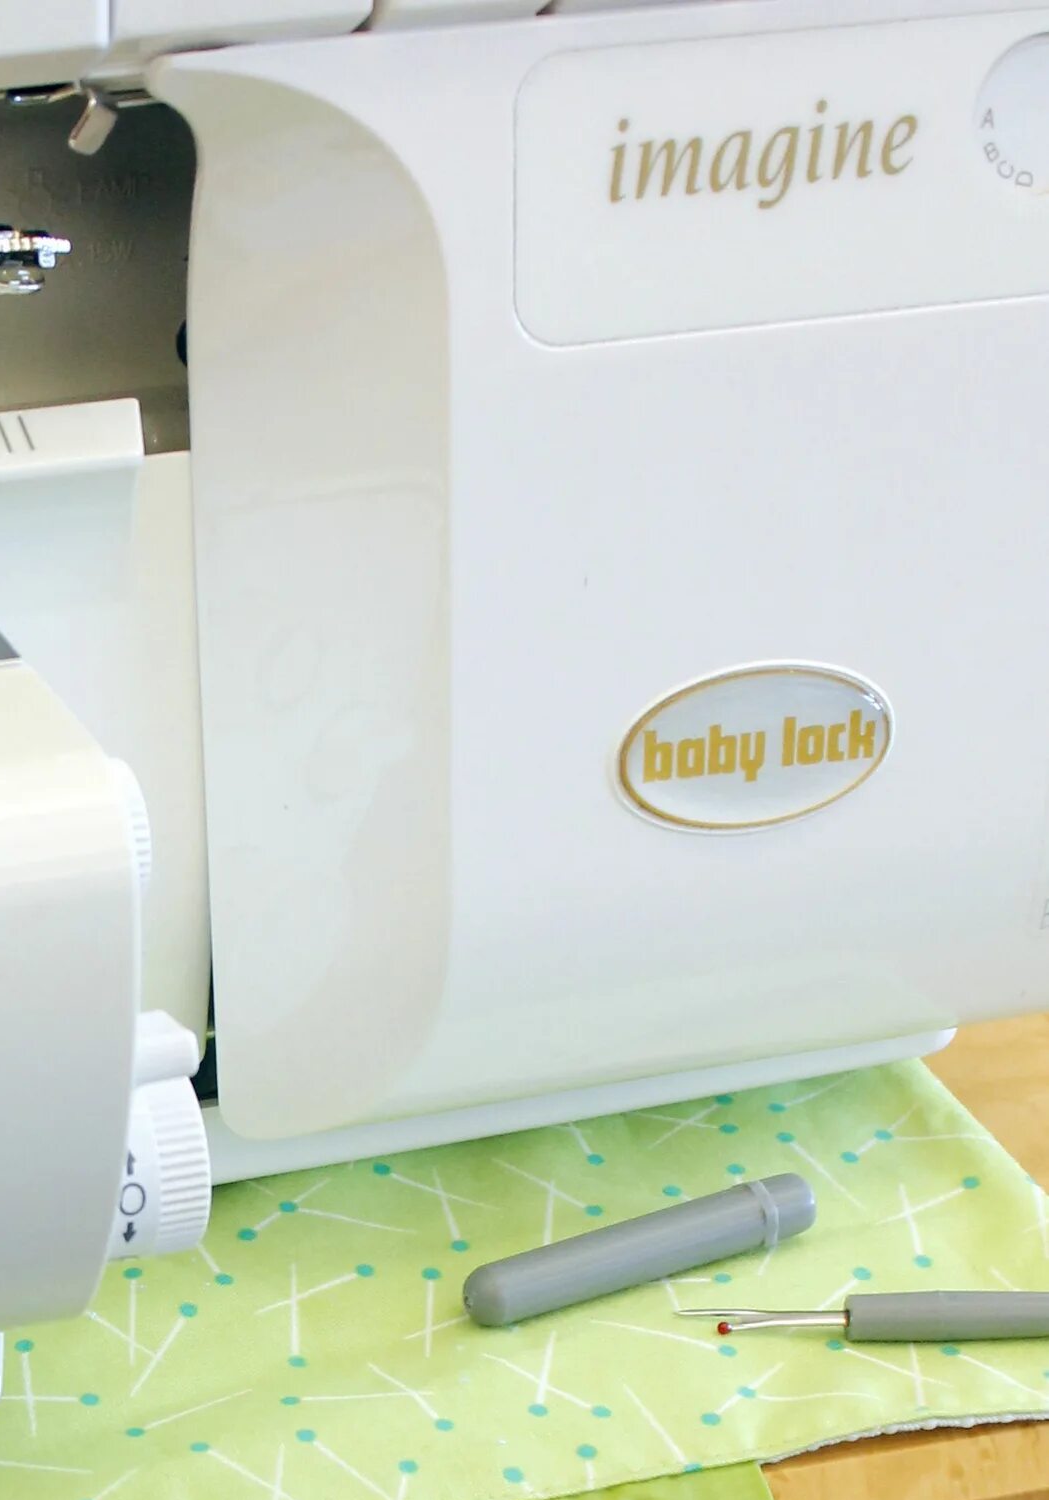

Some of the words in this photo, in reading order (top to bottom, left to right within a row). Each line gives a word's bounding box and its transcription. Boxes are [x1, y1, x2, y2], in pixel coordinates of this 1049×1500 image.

[980, 107, 995, 130] A
[608, 98, 919, 210] imagine
[983, 141, 1001, 164] B
[996, 159, 1015, 180] C
[1014, 170, 1034, 188] D
[642, 723, 766, 783] baby
[781, 709, 877, 768] lock
